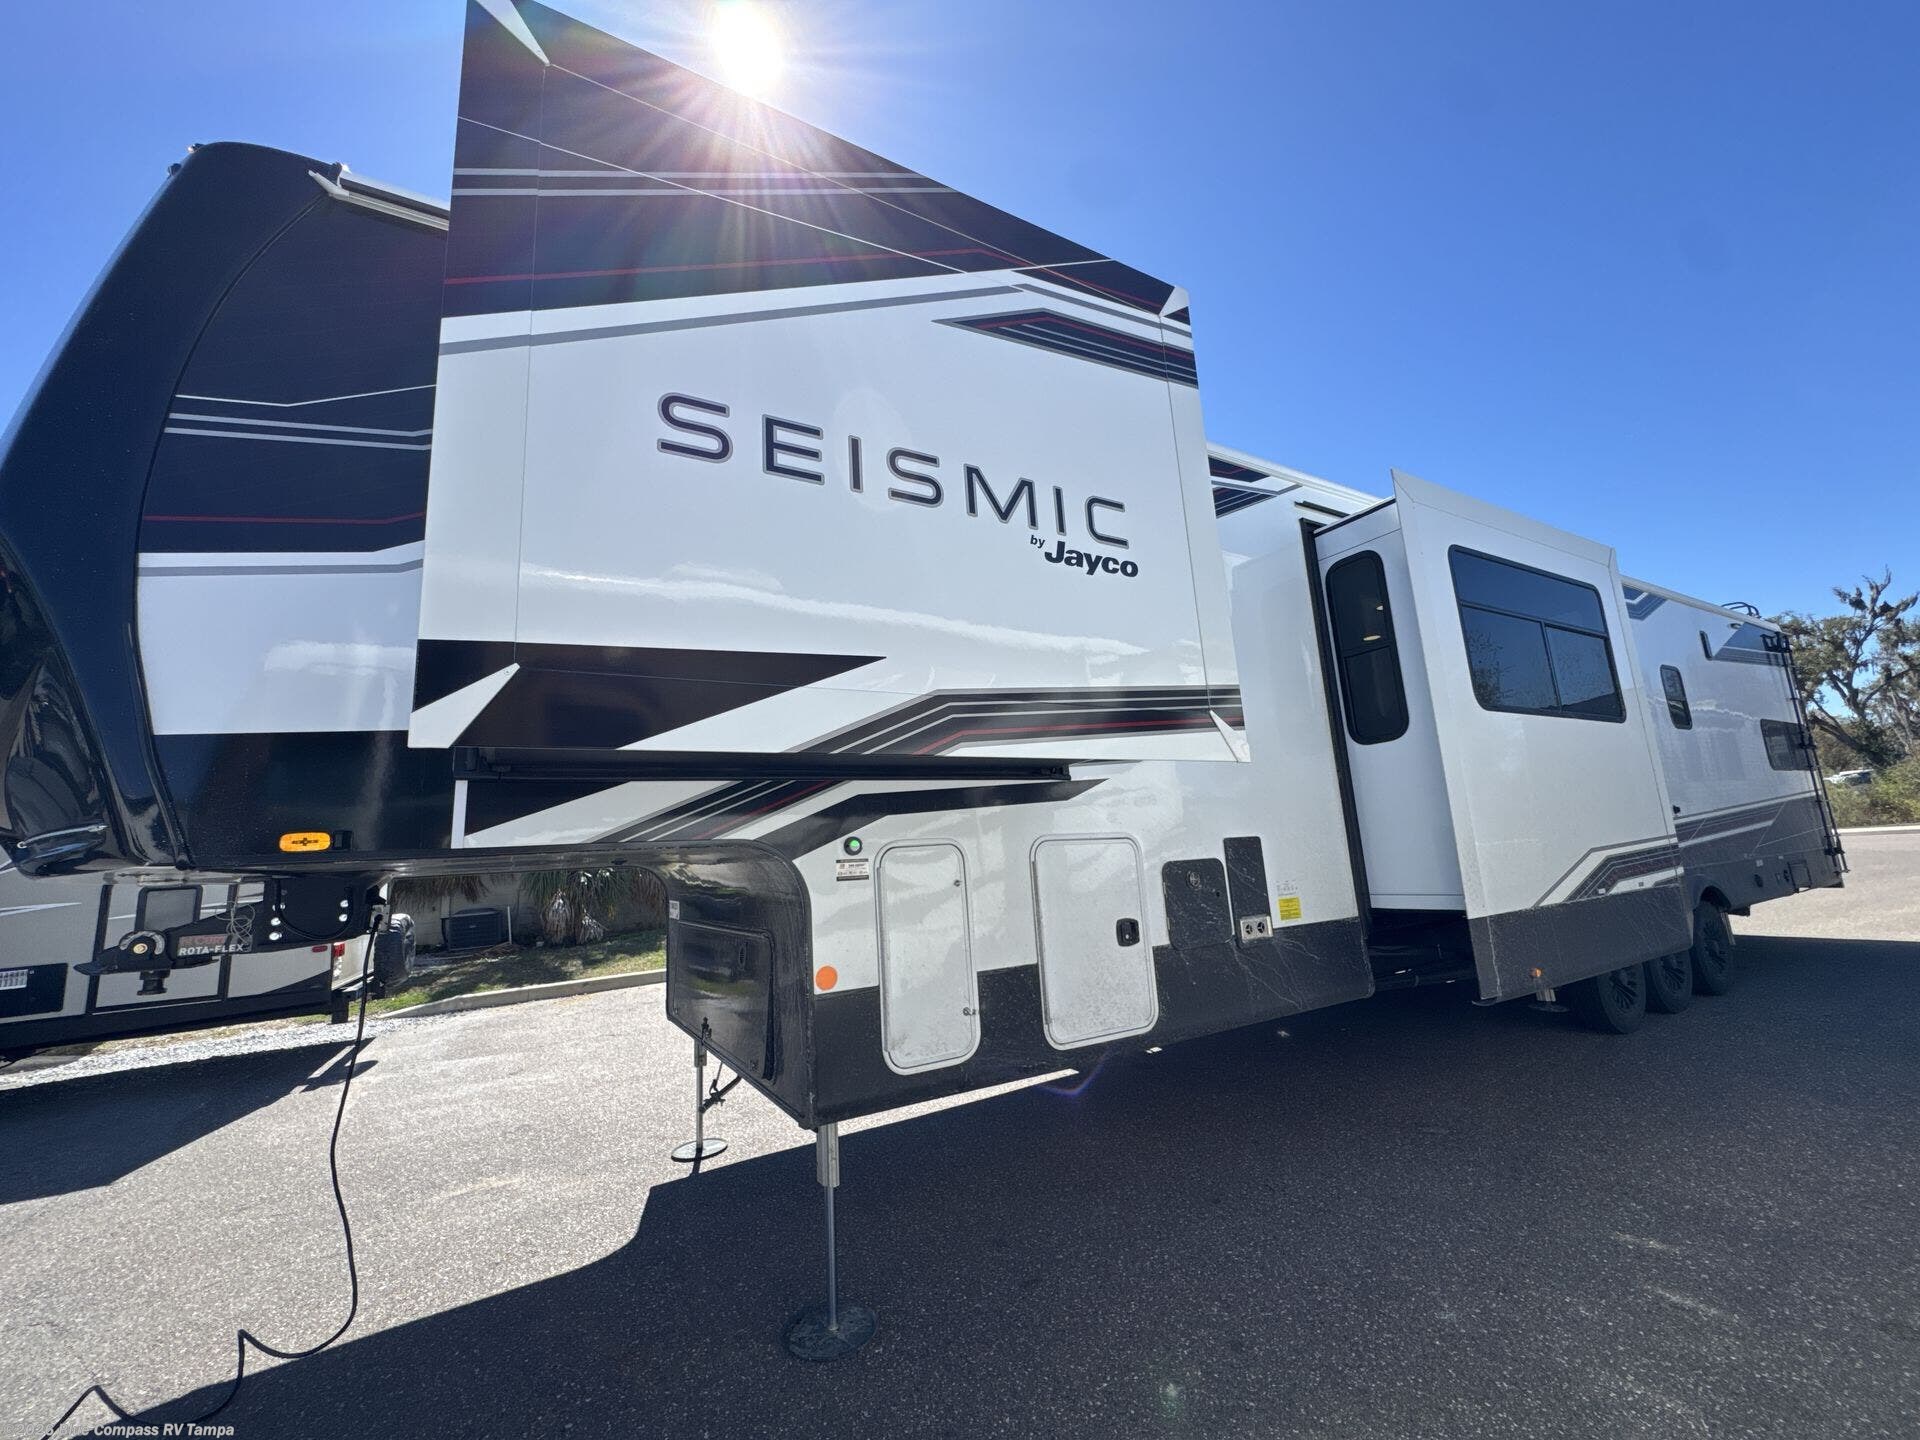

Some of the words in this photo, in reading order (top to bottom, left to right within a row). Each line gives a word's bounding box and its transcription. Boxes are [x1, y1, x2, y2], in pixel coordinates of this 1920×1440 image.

[657, 392, 1130, 550] SEISMIC
[1030, 534, 1046, 549] by
[1044, 540, 1139, 578] Jayco
[179, 944, 243, 955] ROTA-FLEX
